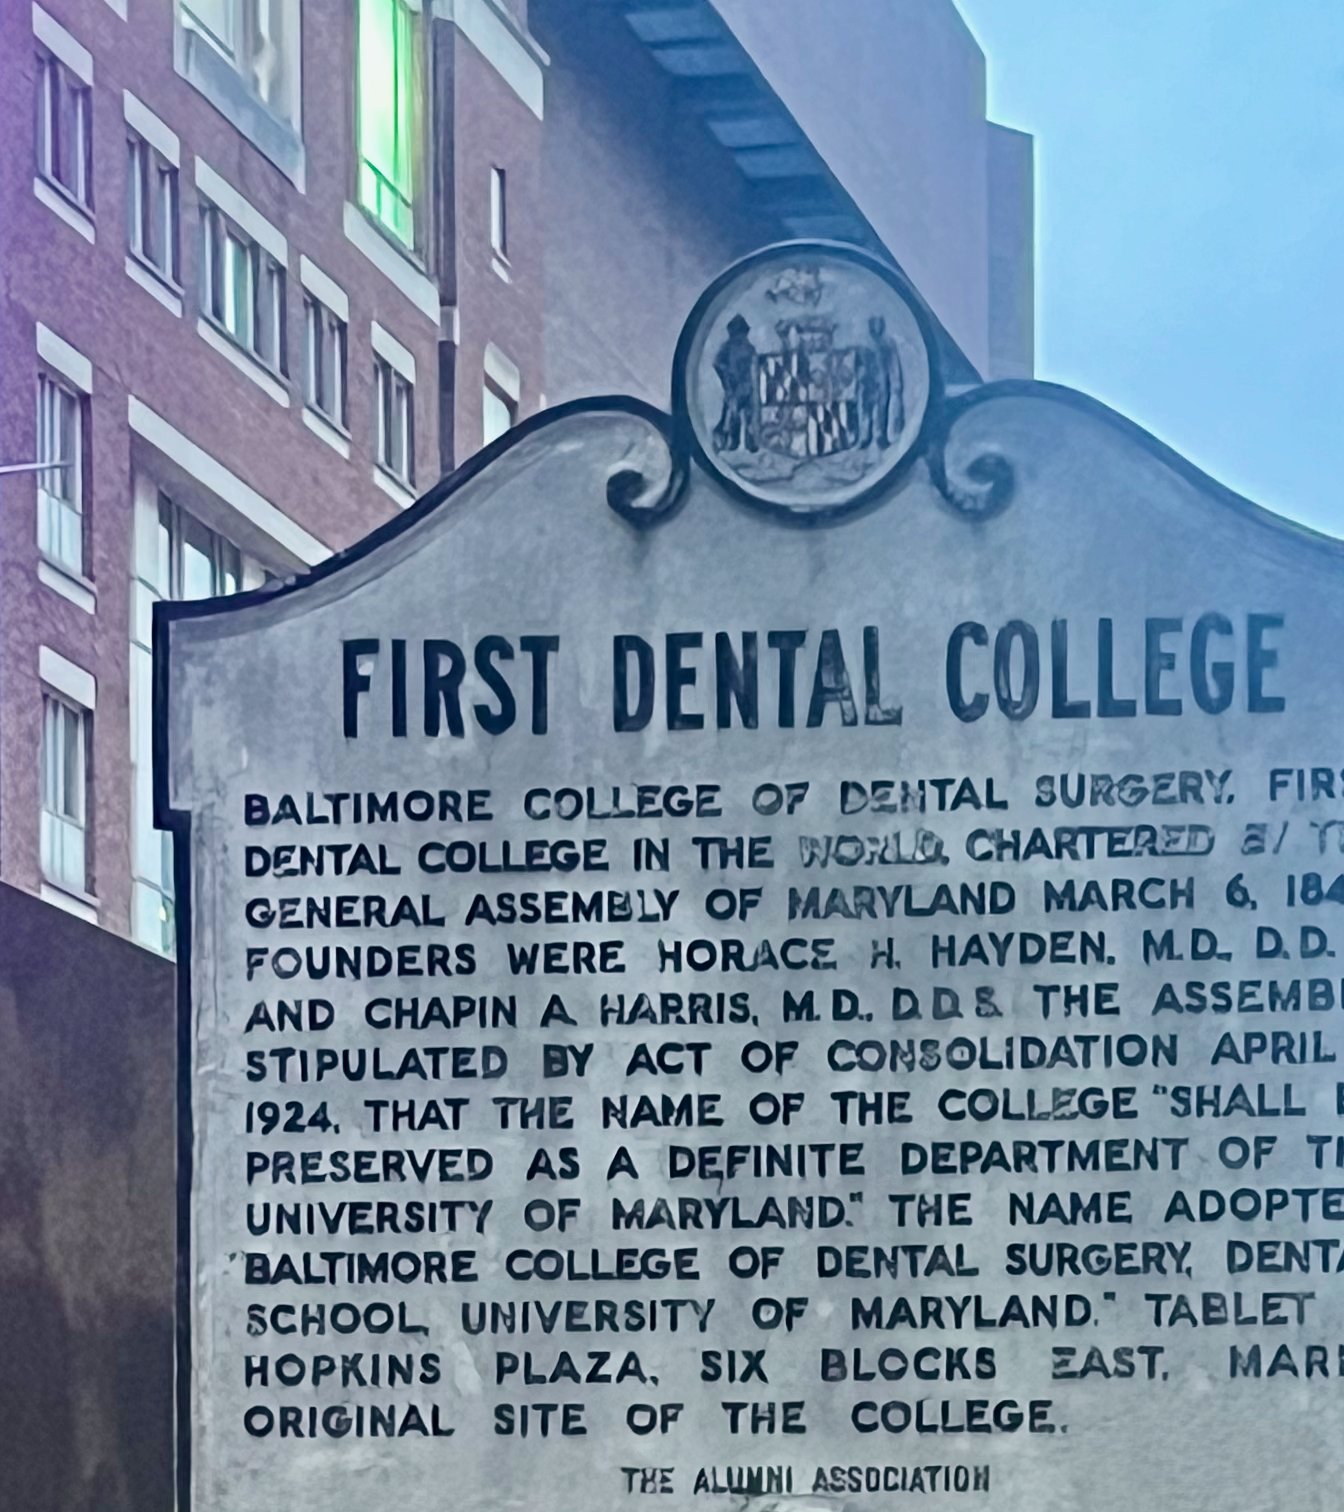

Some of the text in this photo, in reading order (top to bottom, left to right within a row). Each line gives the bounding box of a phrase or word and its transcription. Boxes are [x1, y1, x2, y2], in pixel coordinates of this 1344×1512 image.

[343, 614, 1286, 738] FIRST DENTAL COLLEGE
[244, 790, 493, 827] BALTIMORE
[524, 783, 722, 821] COLLEGE
[752, 782, 809, 816] OF
[840, 777, 1008, 815] DENTAL
[245, 843, 401, 879] DENTAL
[418, 839, 609, 875] COLLEGE
[634, 838, 669, 872] IN
[692, 836, 774, 872] THE
[966, 824, 1215, 862] CHARTERED
[245, 894, 446, 929] GENERAL
[465, 888, 680, 926] ASSEMBLY
[705, 887, 763, 921] OF
[788, 881, 1015, 920] MARYLAND
[1044, 877, 1194, 913] MARCH
[246, 943, 476, 981] FOUNDERS
[507, 940, 626, 975] WERE
[658, 938, 837, 973] HORACE
[244, 999, 334, 1034] AND
[365, 995, 517, 1030] CHAPIN
[1033, 983, 1120, 1020] THE
[246, 1045, 508, 1083] STIPULATED
[543, 1043, 594, 1079] BY
[626, 1042, 712, 1079] ACT
[741, 1040, 799, 1076] OF
[827, 1034, 1177, 1073] CONSOLIDATION
[1211, 1031, 1336, 1065] APRIL
[364, 1098, 470, 1132] THAT
[492, 1096, 574, 1130] THE
[602, 1094, 724, 1129] NAME
[749, 1092, 804, 1126] OF
[830, 1091, 913, 1126] THE
[938, 1087, 1138, 1122] COLLEGE
[247, 1148, 493, 1187] PRESERVED
[526, 1147, 580, 1181] AS
[607, 1146, 638, 1182] A
[669, 1143, 865, 1180] DEFINITE
[901, 1137, 1189, 1175] DEPARTMENT
[1219, 1136, 1277, 1170] OF
[247, 1200, 493, 1236] UNIVERSITY
[524, 1198, 581, 1232] OF
[888, 1193, 972, 1228] THE
[1010, 1191, 1132, 1226] NAME
[506, 1248, 700, 1281] COLLEGE
[729, 1246, 784, 1280] OF
[817, 1243, 979, 1279] DENTAL
[462, 1299, 715, 1335] UNIVERSITY
[752, 1297, 808, 1332] OF
[1148, 1292, 1316, 1327] TABLET
[244, 1353, 441, 1389] HOPKINS
[700, 1349, 768, 1384] SIX
[821, 1347, 996, 1382] BLOCKS
[244, 1400, 455, 1439] ORIGINAL
[494, 1404, 587, 1438] SITE
[626, 1403, 684, 1435] OF
[721, 1401, 806, 1434] THE
[620, 1465, 990, 1496] THE ALUMNI ASSOCIATION
